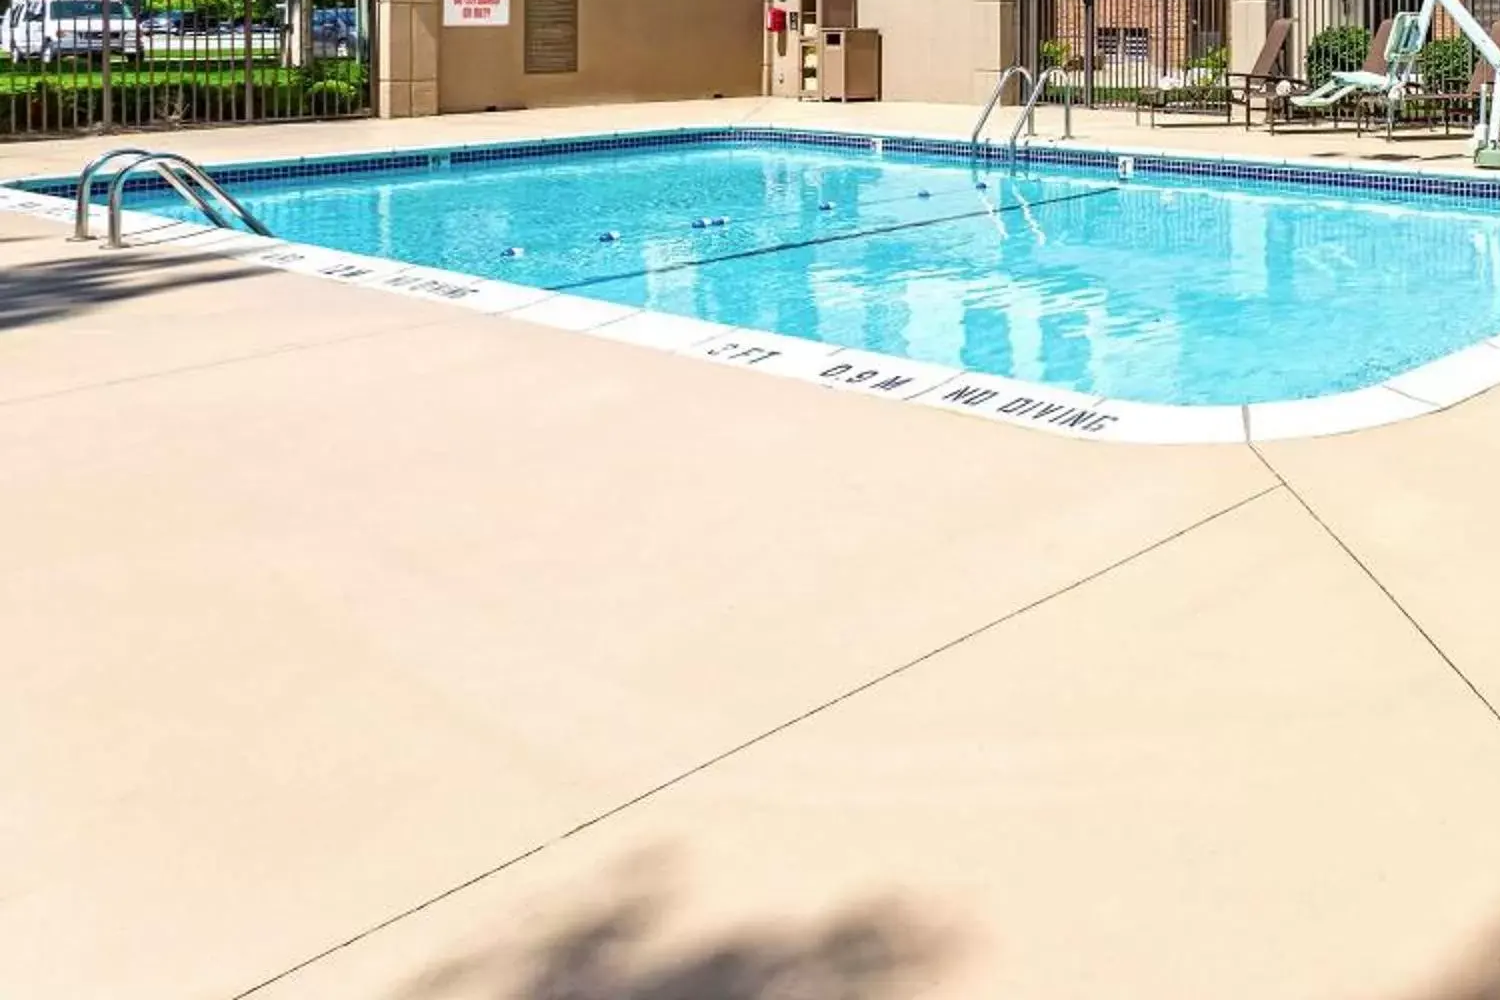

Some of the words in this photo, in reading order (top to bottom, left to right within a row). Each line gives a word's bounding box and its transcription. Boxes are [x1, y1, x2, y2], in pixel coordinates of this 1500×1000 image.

[727, 346, 783, 365] FT
[819, 363, 879, 384] 0.9
[869, 375, 915, 391] M
[942, 384, 999, 407] NO
[996, 396, 1119, 432] DIVING
